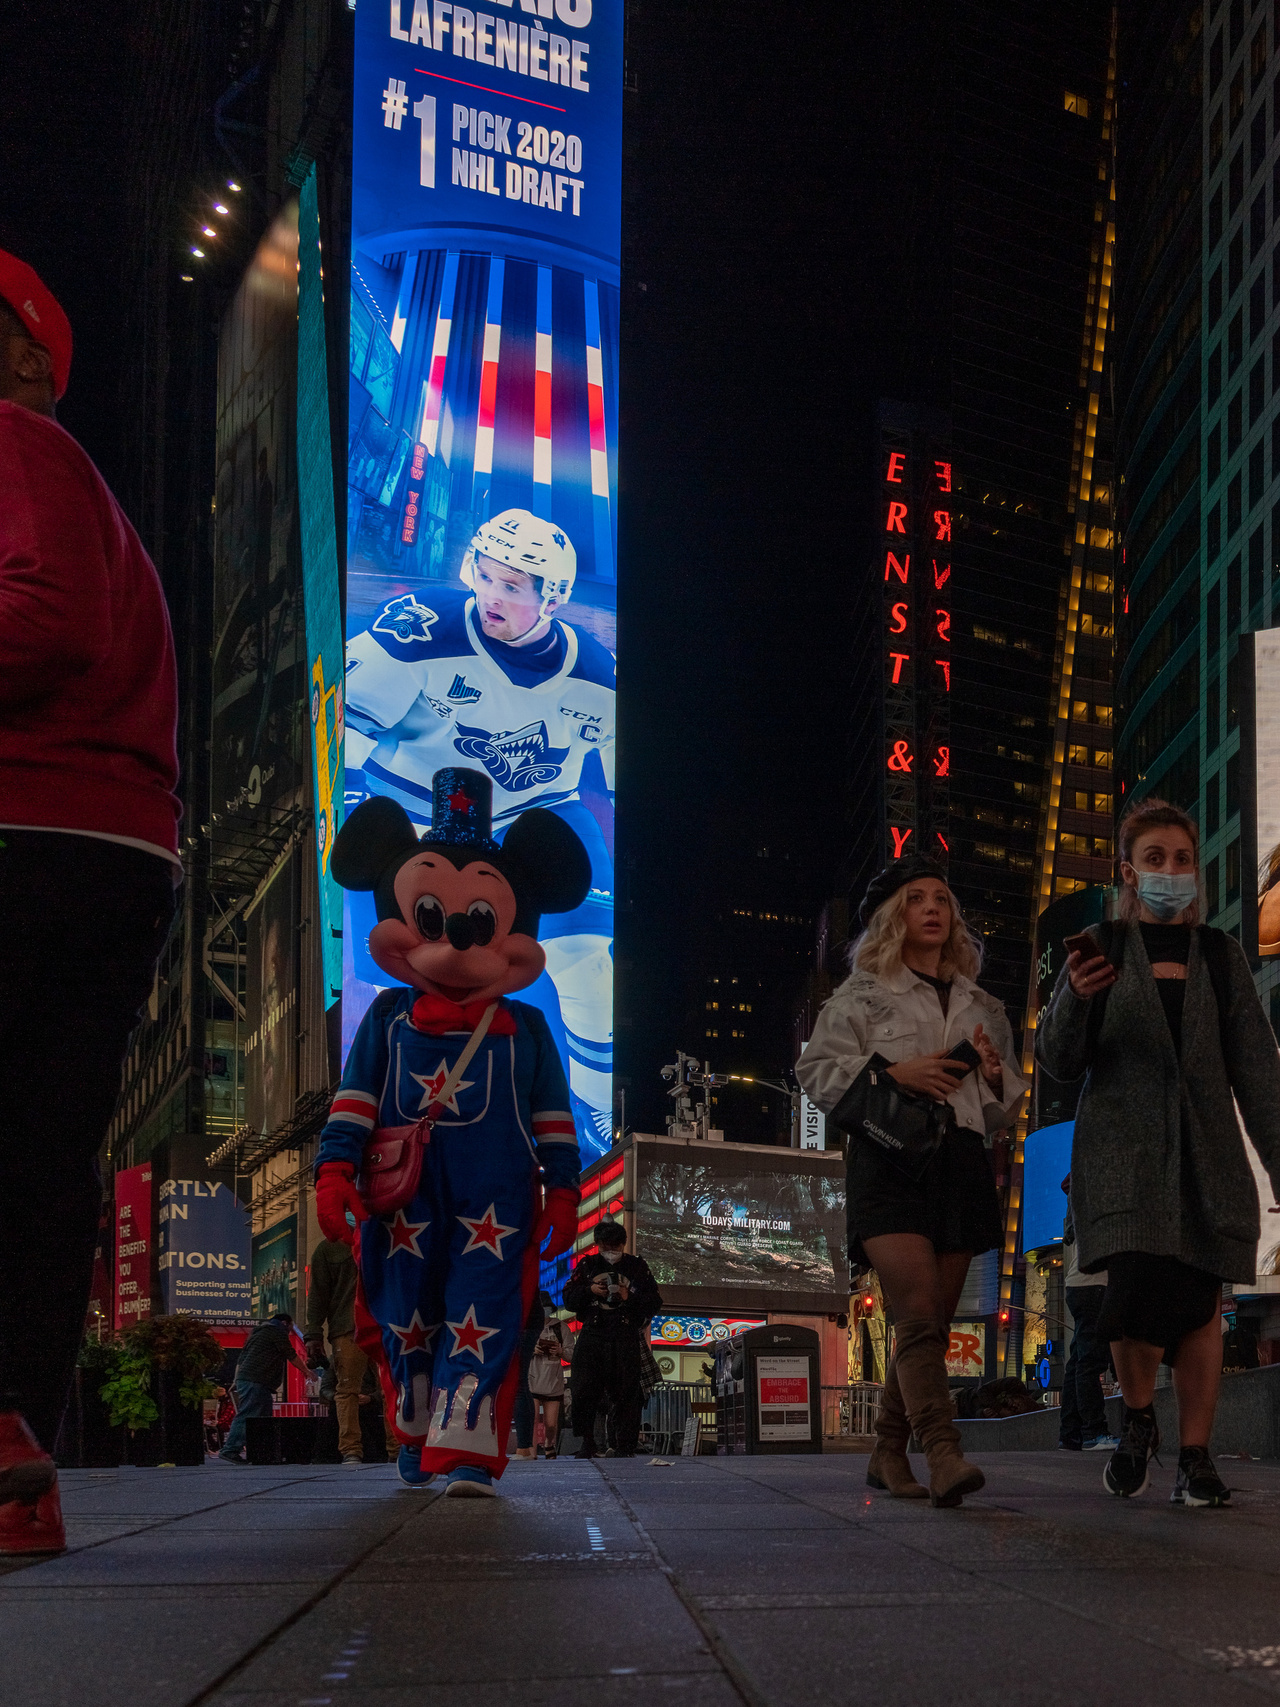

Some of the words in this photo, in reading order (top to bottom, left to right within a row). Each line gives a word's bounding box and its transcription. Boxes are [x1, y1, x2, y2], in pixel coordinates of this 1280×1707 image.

[390, 0, 590, 93] LAFRENIÈRE
[382, 77, 437, 189] #1
[452, 103, 512, 156] PICK
[516, 121, 583, 174] 2020
[452, 147, 500, 197] NHL
[505, 161, 585, 217] DRAFT
[410, 444, 427, 482] NEW
[402, 490, 420, 544] YORK
[487, 534, 516, 550] CCM
[884, 452, 910, 685] ERNST
[559, 706, 603, 724] CCM
[577, 723, 604, 744] C
[886, 740, 915, 772] &
[863, 1119, 886, 1139] CALVIN
[885, 1135, 904, 1150] KLEIN
[119, 1205, 132, 1219] ARE
[119, 1224, 131, 1239] THE
[118, 1240, 147, 1258] BENEFITS
[118, 1262, 132, 1277] YOU
[118, 1281, 138, 1296] OFFER
[175, 1279, 226, 1291] Supporting
[227, 1279, 251, 1289] small
[175, 1288, 224, 1298] businesses
[225, 1290, 237, 1298] for
[203, 1308, 243, 1317] standing
[766, 1379, 802, 1387] EMBRACE
[768, 1395, 800, 1403] ABSURD
